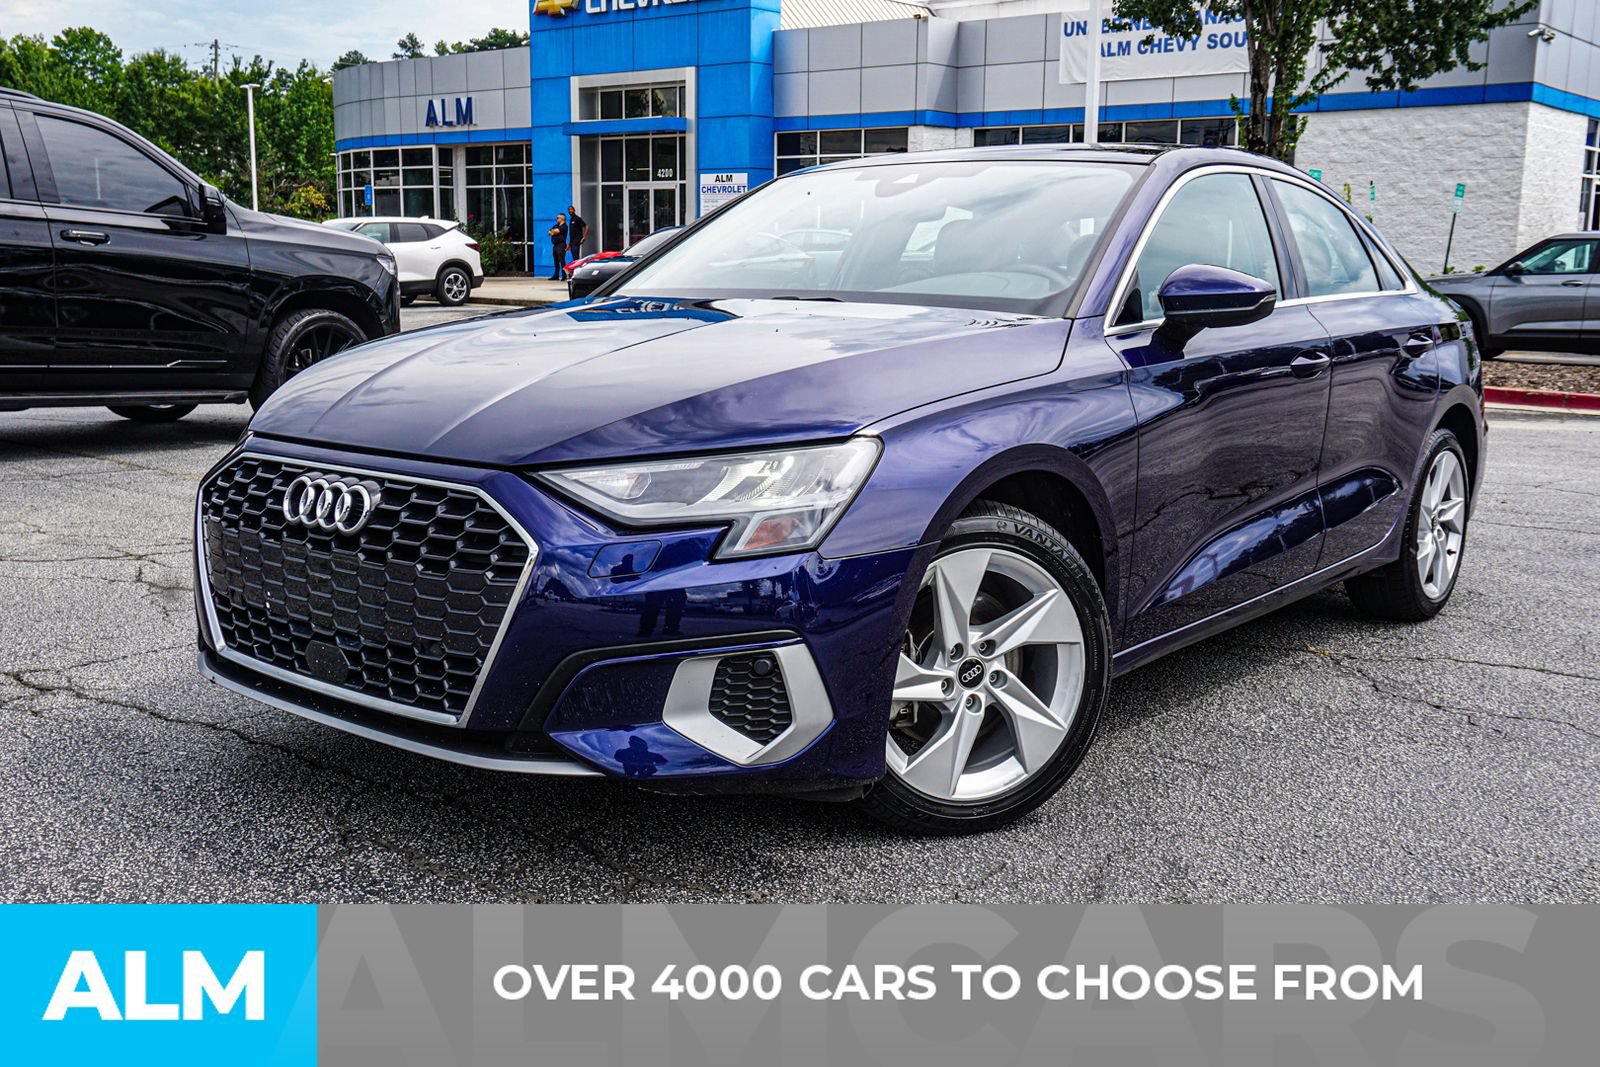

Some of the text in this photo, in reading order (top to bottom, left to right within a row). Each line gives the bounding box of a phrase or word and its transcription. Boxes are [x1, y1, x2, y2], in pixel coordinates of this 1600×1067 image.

[425, 97, 473, 127] ALM
[657, 168, 673, 178] 4200
[715, 174, 733, 183] ALM
[701, 185, 747, 194] CHEVROLET
